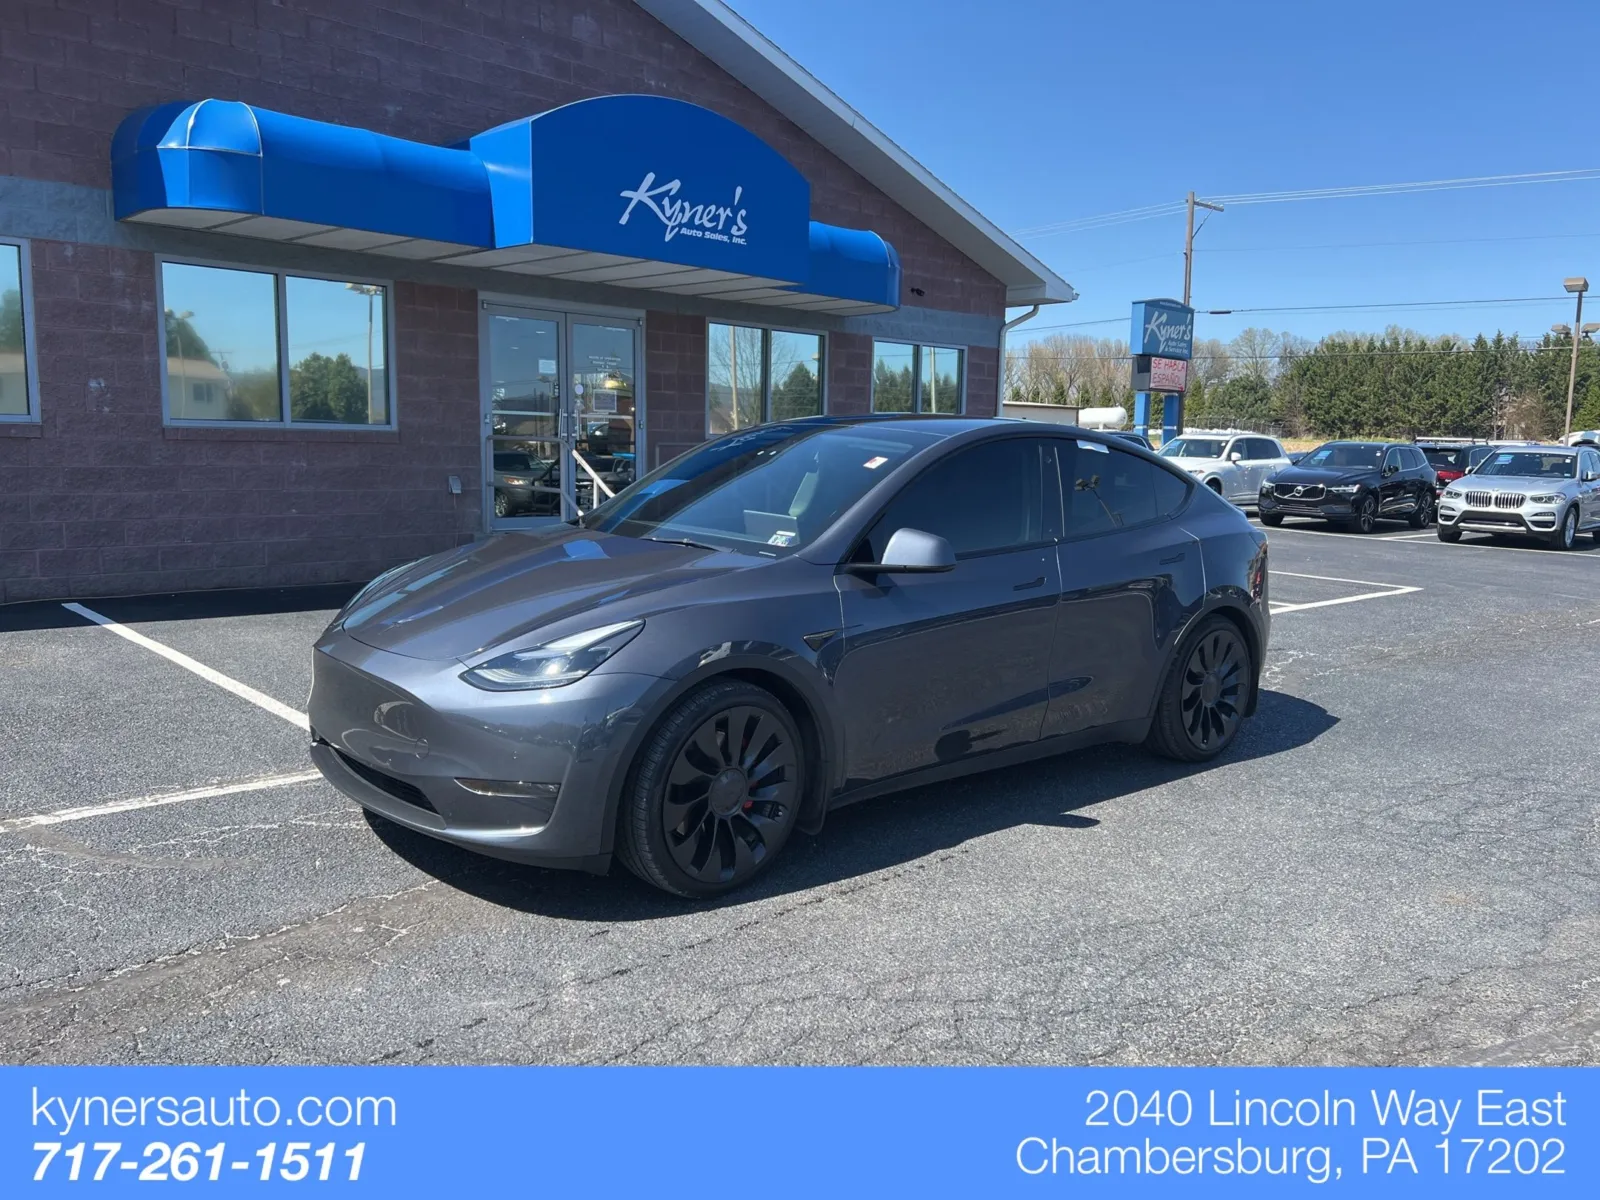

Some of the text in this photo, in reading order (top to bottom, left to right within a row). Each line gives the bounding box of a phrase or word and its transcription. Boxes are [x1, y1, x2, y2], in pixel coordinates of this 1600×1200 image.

[619, 172, 748, 242] Kyner's
[680, 227, 747, 245] Auto Sales, Inc.
[1144, 311, 1191, 354] Kyner's
[1152, 359, 1185, 372] SE HABLA
